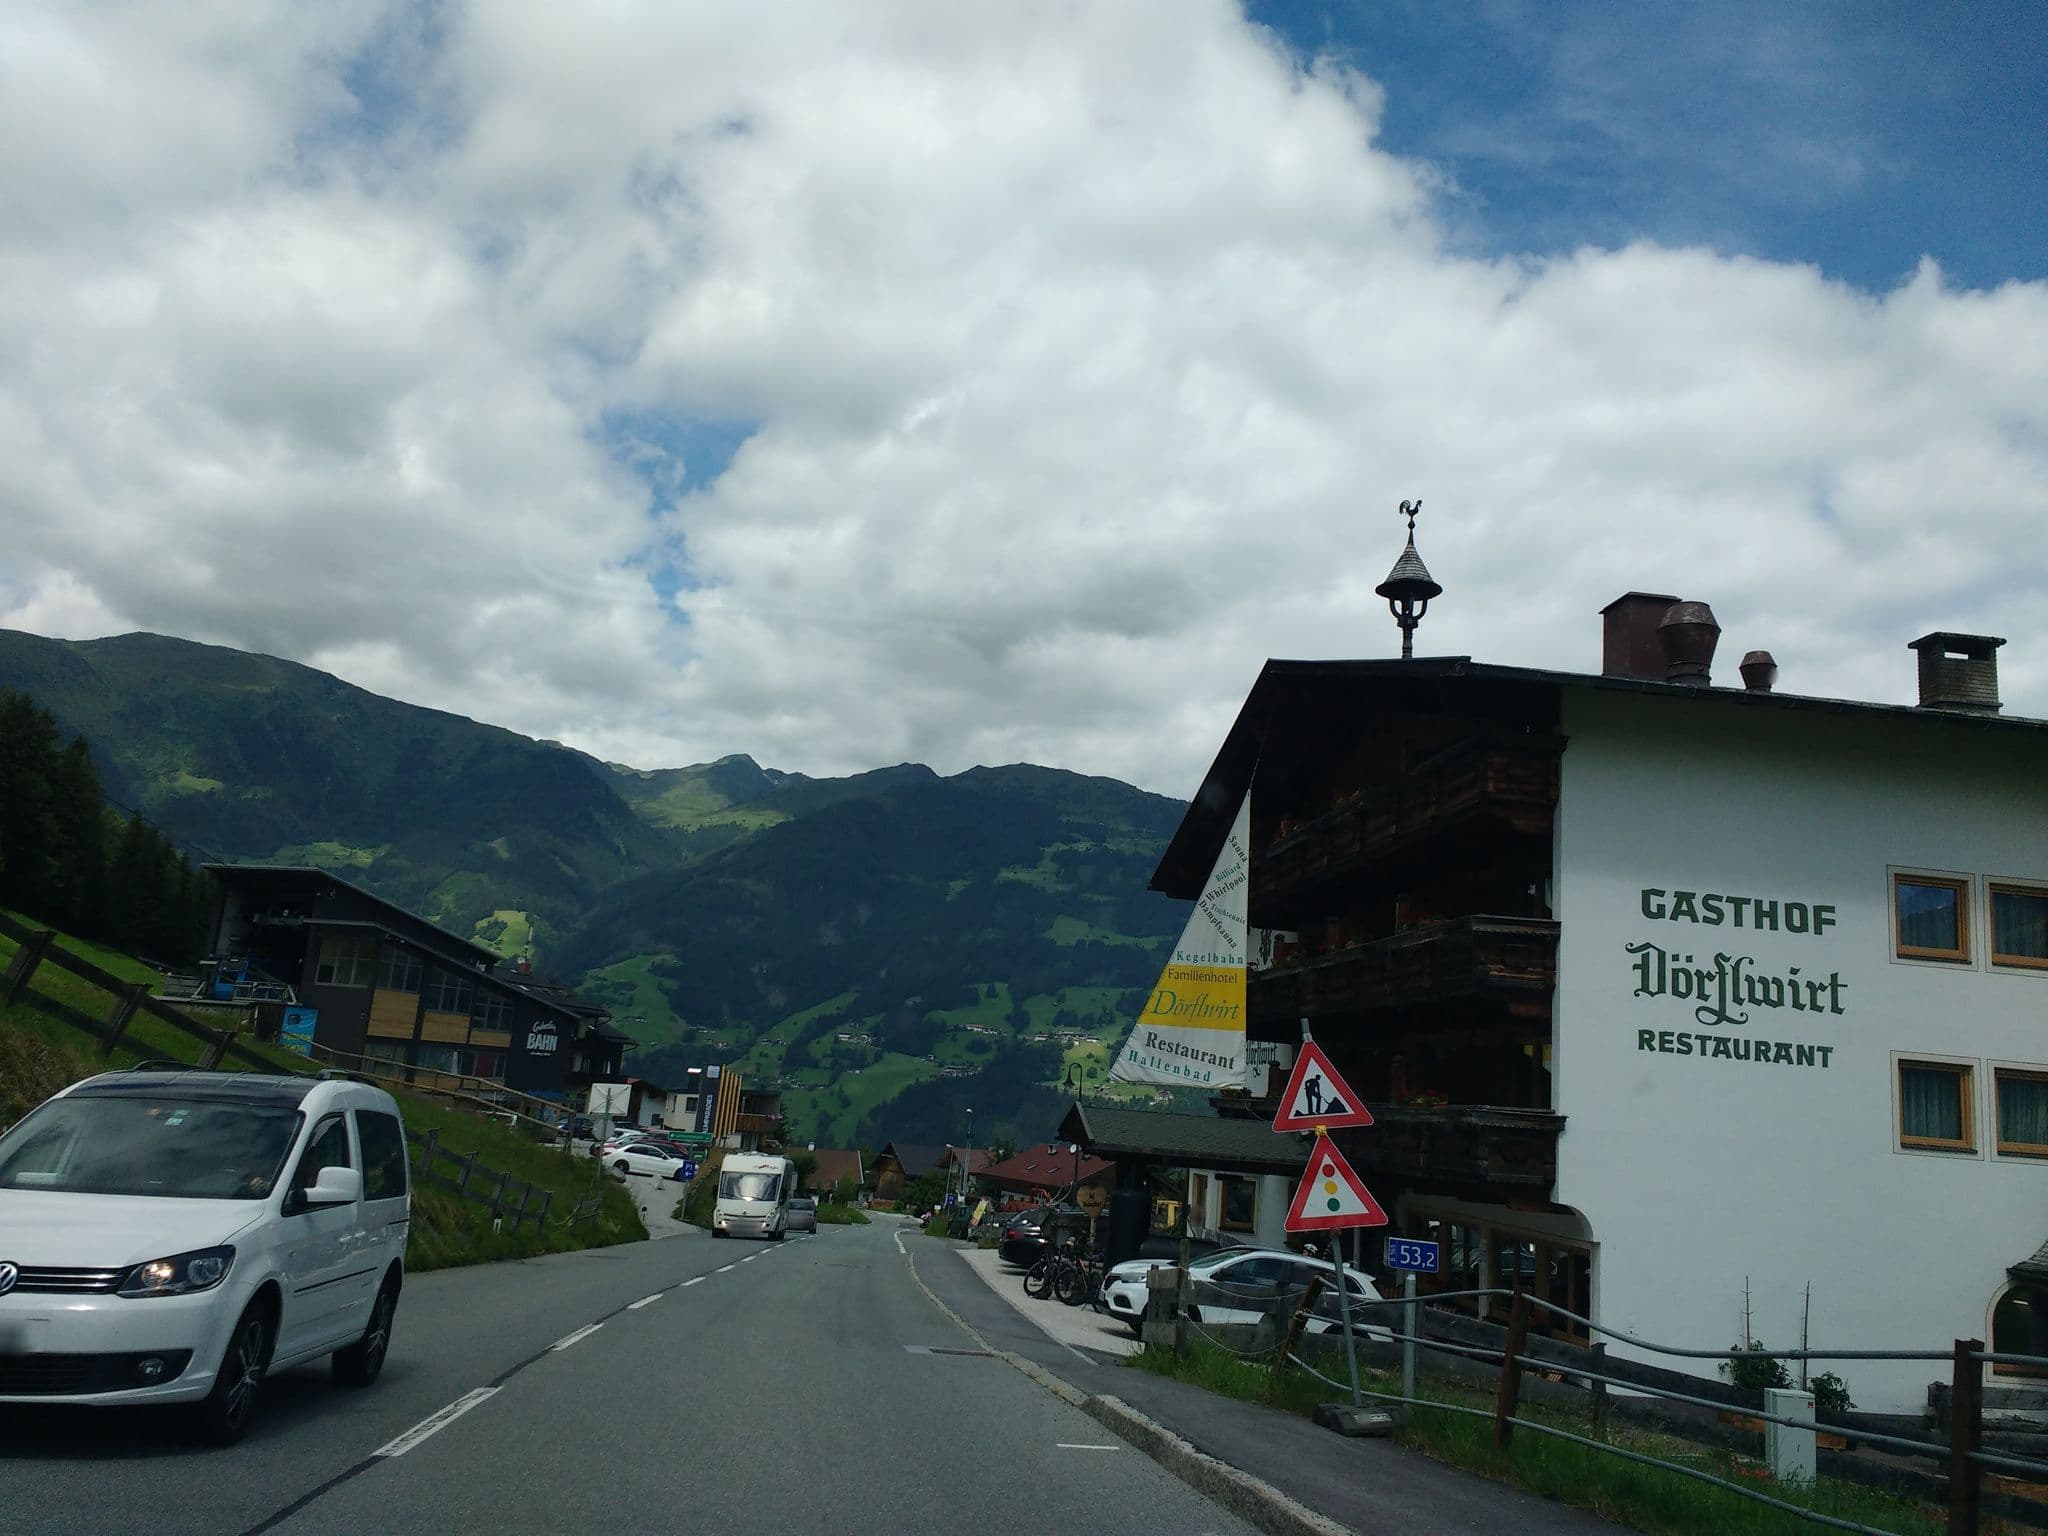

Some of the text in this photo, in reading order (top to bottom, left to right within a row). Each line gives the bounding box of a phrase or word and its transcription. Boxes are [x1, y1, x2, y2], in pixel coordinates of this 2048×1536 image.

[1229, 835, 1248, 863] Sauna
[1205, 872, 1247, 902] Whirlpool
[1215, 862, 1241, 882] Billiard
[1198, 900, 1237, 949] Dampfsauna
[1210, 903, 1247, 925] Tischtennis
[1641, 888, 1836, 936] GASTHOF
[1176, 950, 1244, 965] Kegelbahn
[1168, 968, 1238, 984] Familienhotel
[1624, 941, 1848, 1026] Dörflwirt
[1151, 990, 1240, 1024] Dörflwirt
[526, 1032, 558, 1052] BAHN
[1145, 1031, 1235, 1070] Restaurant
[1637, 1028, 1834, 1068] RESTAURANT
[1128, 1050, 1212, 1083] Hallenbad
[1400, 1245, 1435, 1268] 53,2
